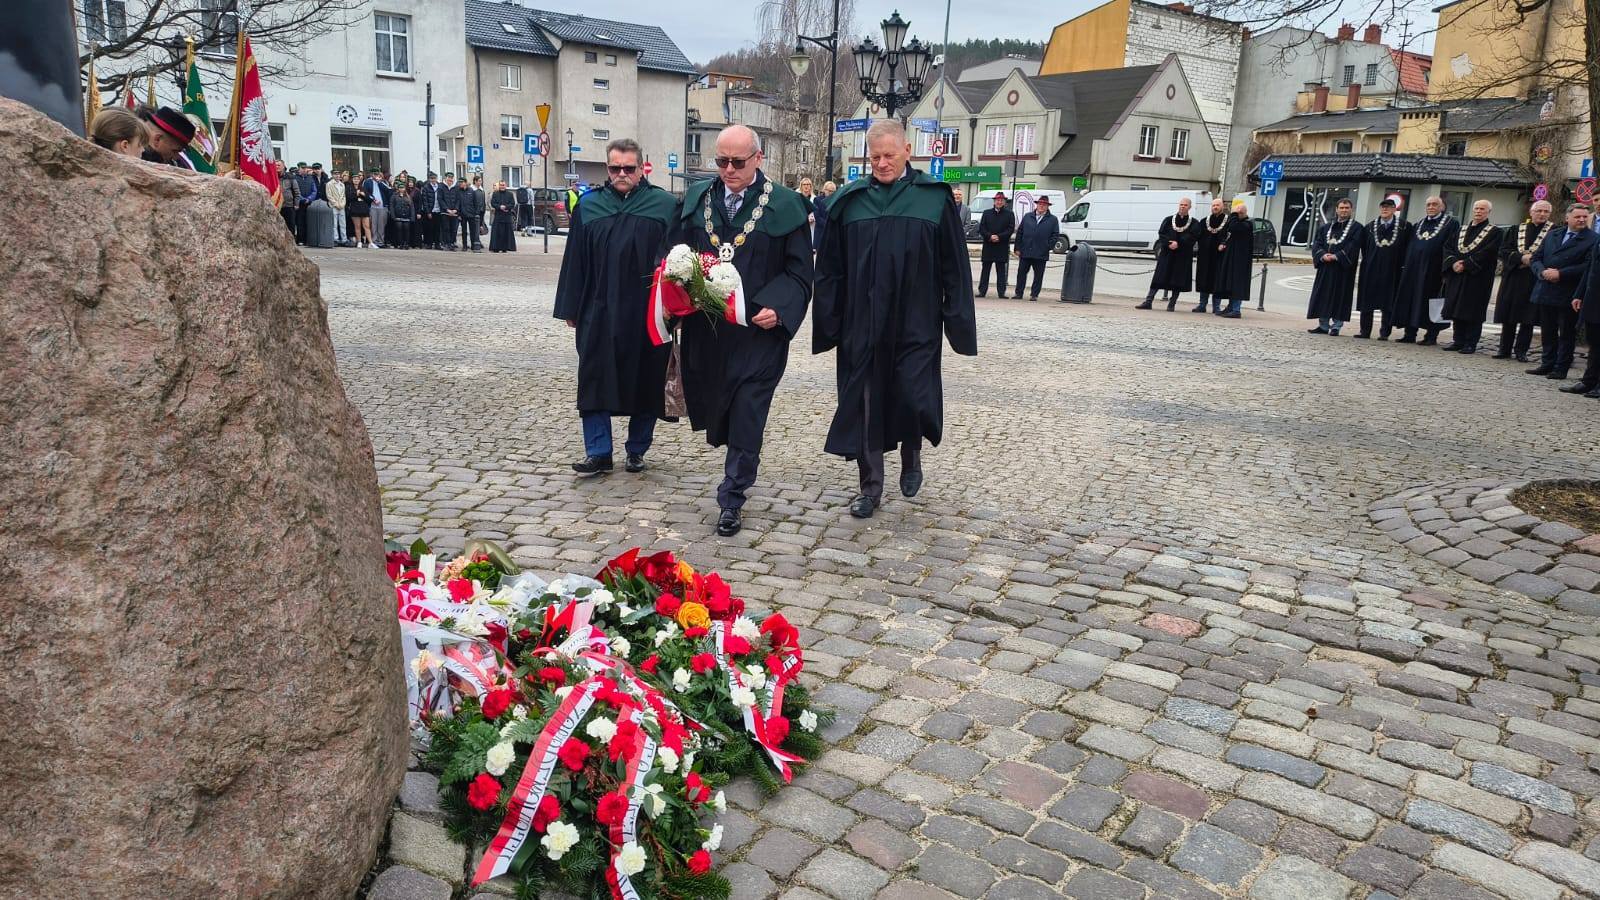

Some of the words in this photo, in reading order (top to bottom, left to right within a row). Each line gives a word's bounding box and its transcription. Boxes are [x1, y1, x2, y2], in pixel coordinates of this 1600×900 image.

[529, 137, 538, 152] P
[471, 148, 480, 161] P
[850, 167, 857, 177] P
[1264, 180, 1274, 194] P
